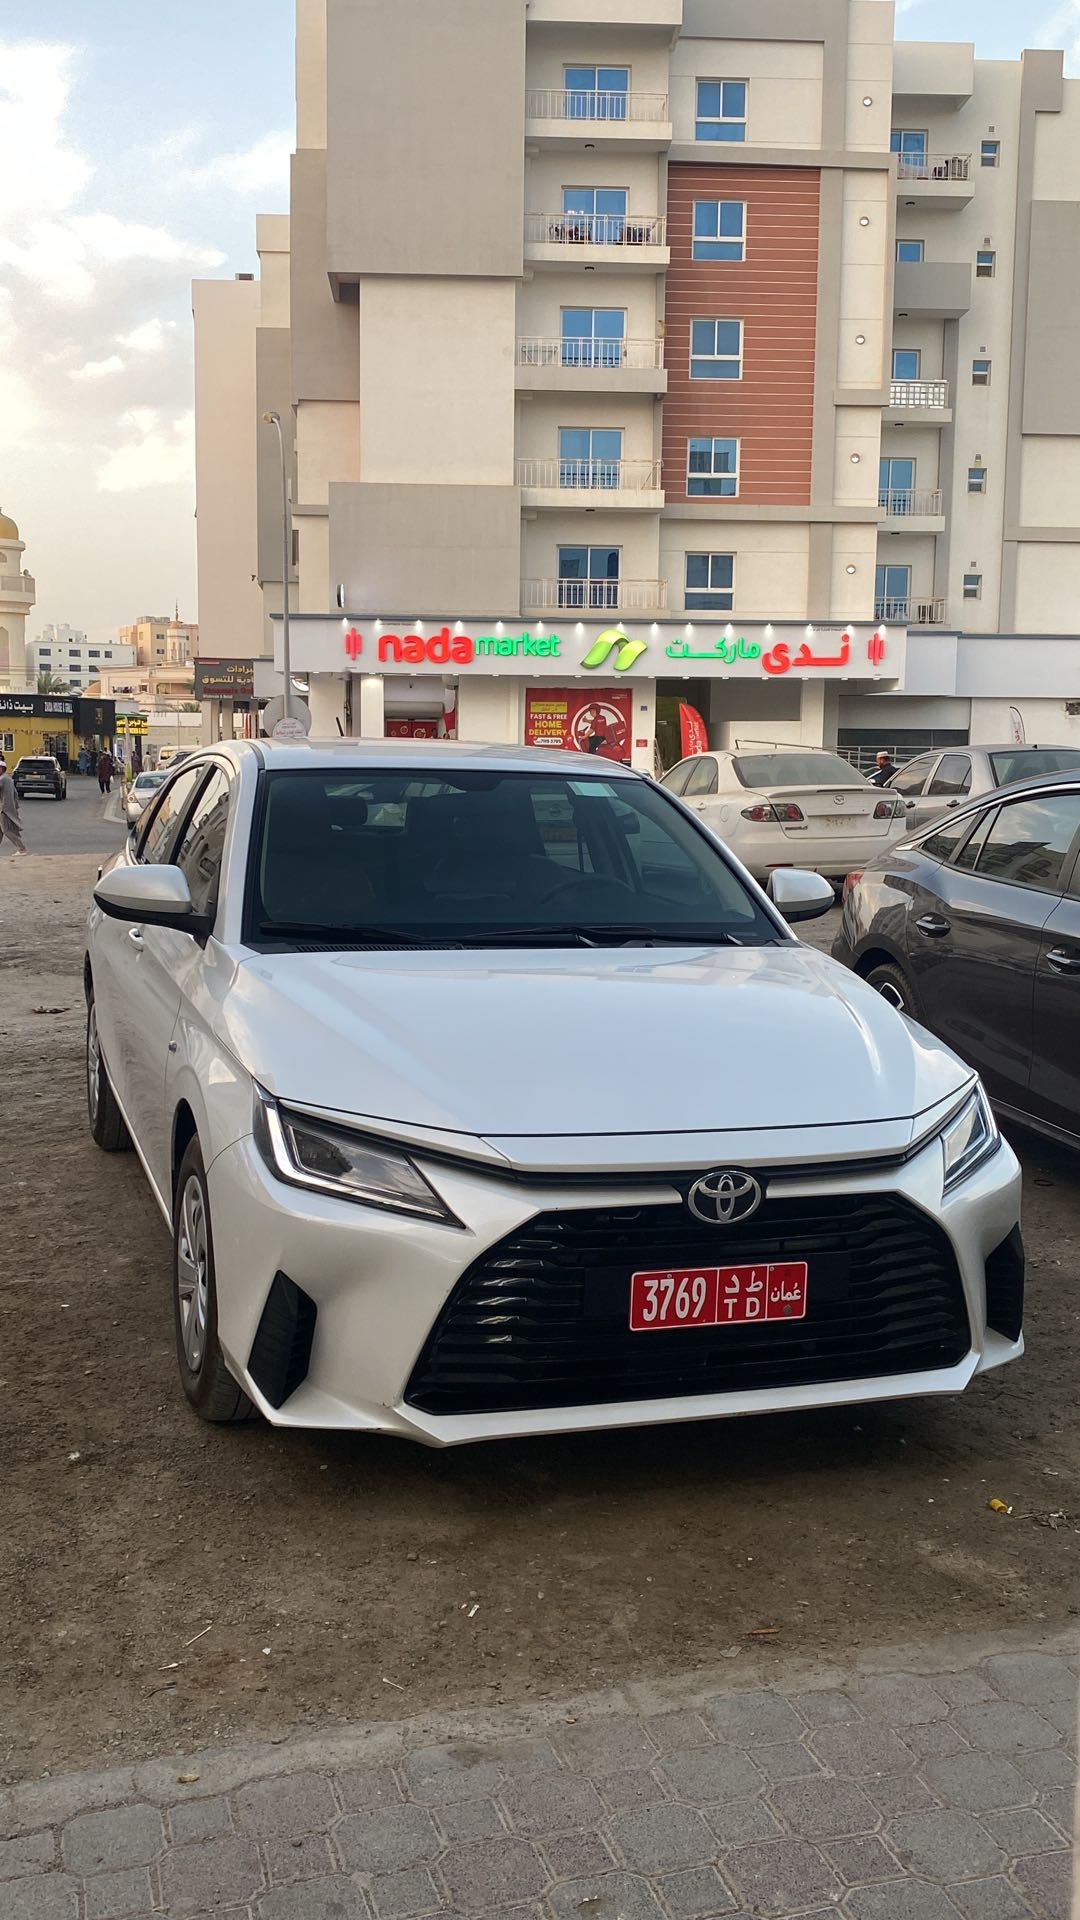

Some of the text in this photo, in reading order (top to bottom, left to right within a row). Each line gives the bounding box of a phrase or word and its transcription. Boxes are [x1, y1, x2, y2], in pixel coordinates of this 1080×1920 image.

[378, 627, 561, 664] nada market
[665, 633, 851, 674] ندى ماركت
[534, 720, 562, 728] HOME
[643, 1276, 707, 1322] 3769
